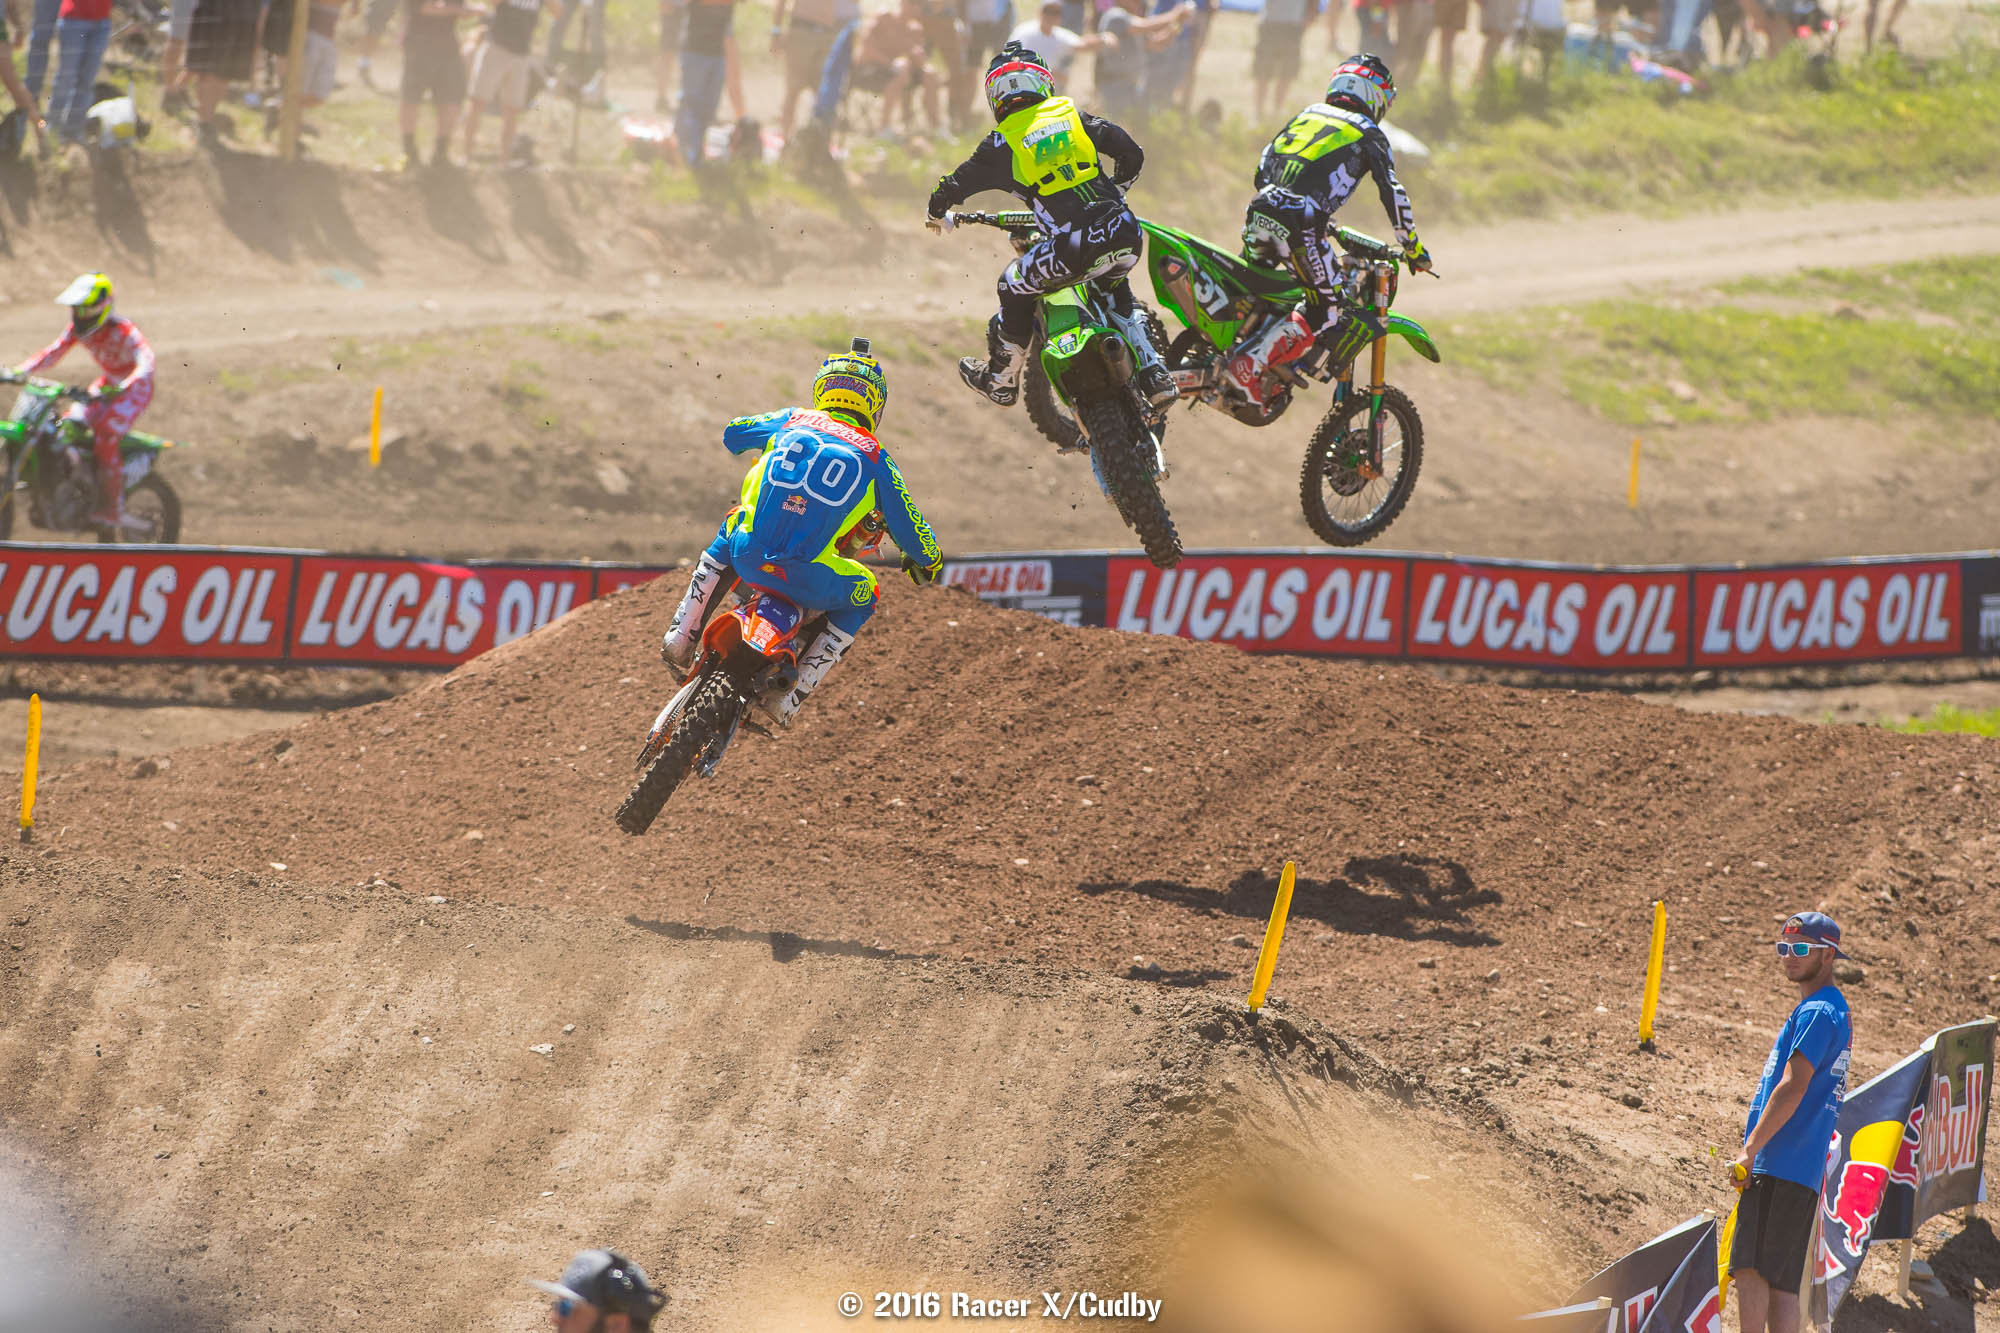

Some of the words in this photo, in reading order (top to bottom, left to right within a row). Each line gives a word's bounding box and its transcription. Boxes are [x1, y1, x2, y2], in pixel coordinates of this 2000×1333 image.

[1273, 112, 1363, 162] 37
[1254, 213, 1289, 240] VERSACE
[1194, 270, 1229, 316] 37
[824, 376, 869, 395] SHANE
[767, 429, 862, 506] 30
[181, 565, 276, 645] OIL
[299, 571, 485, 653] LUCAS
[1117, 567, 1308, 640] LUCAS
[1311, 567, 1392, 641] OIL
[1414, 573, 1587, 655] LUCAS
[1594, 583, 1676, 655] OIL
[1701, 576, 1871, 653] LUCAS
[1876, 572, 1949, 646] OIL
